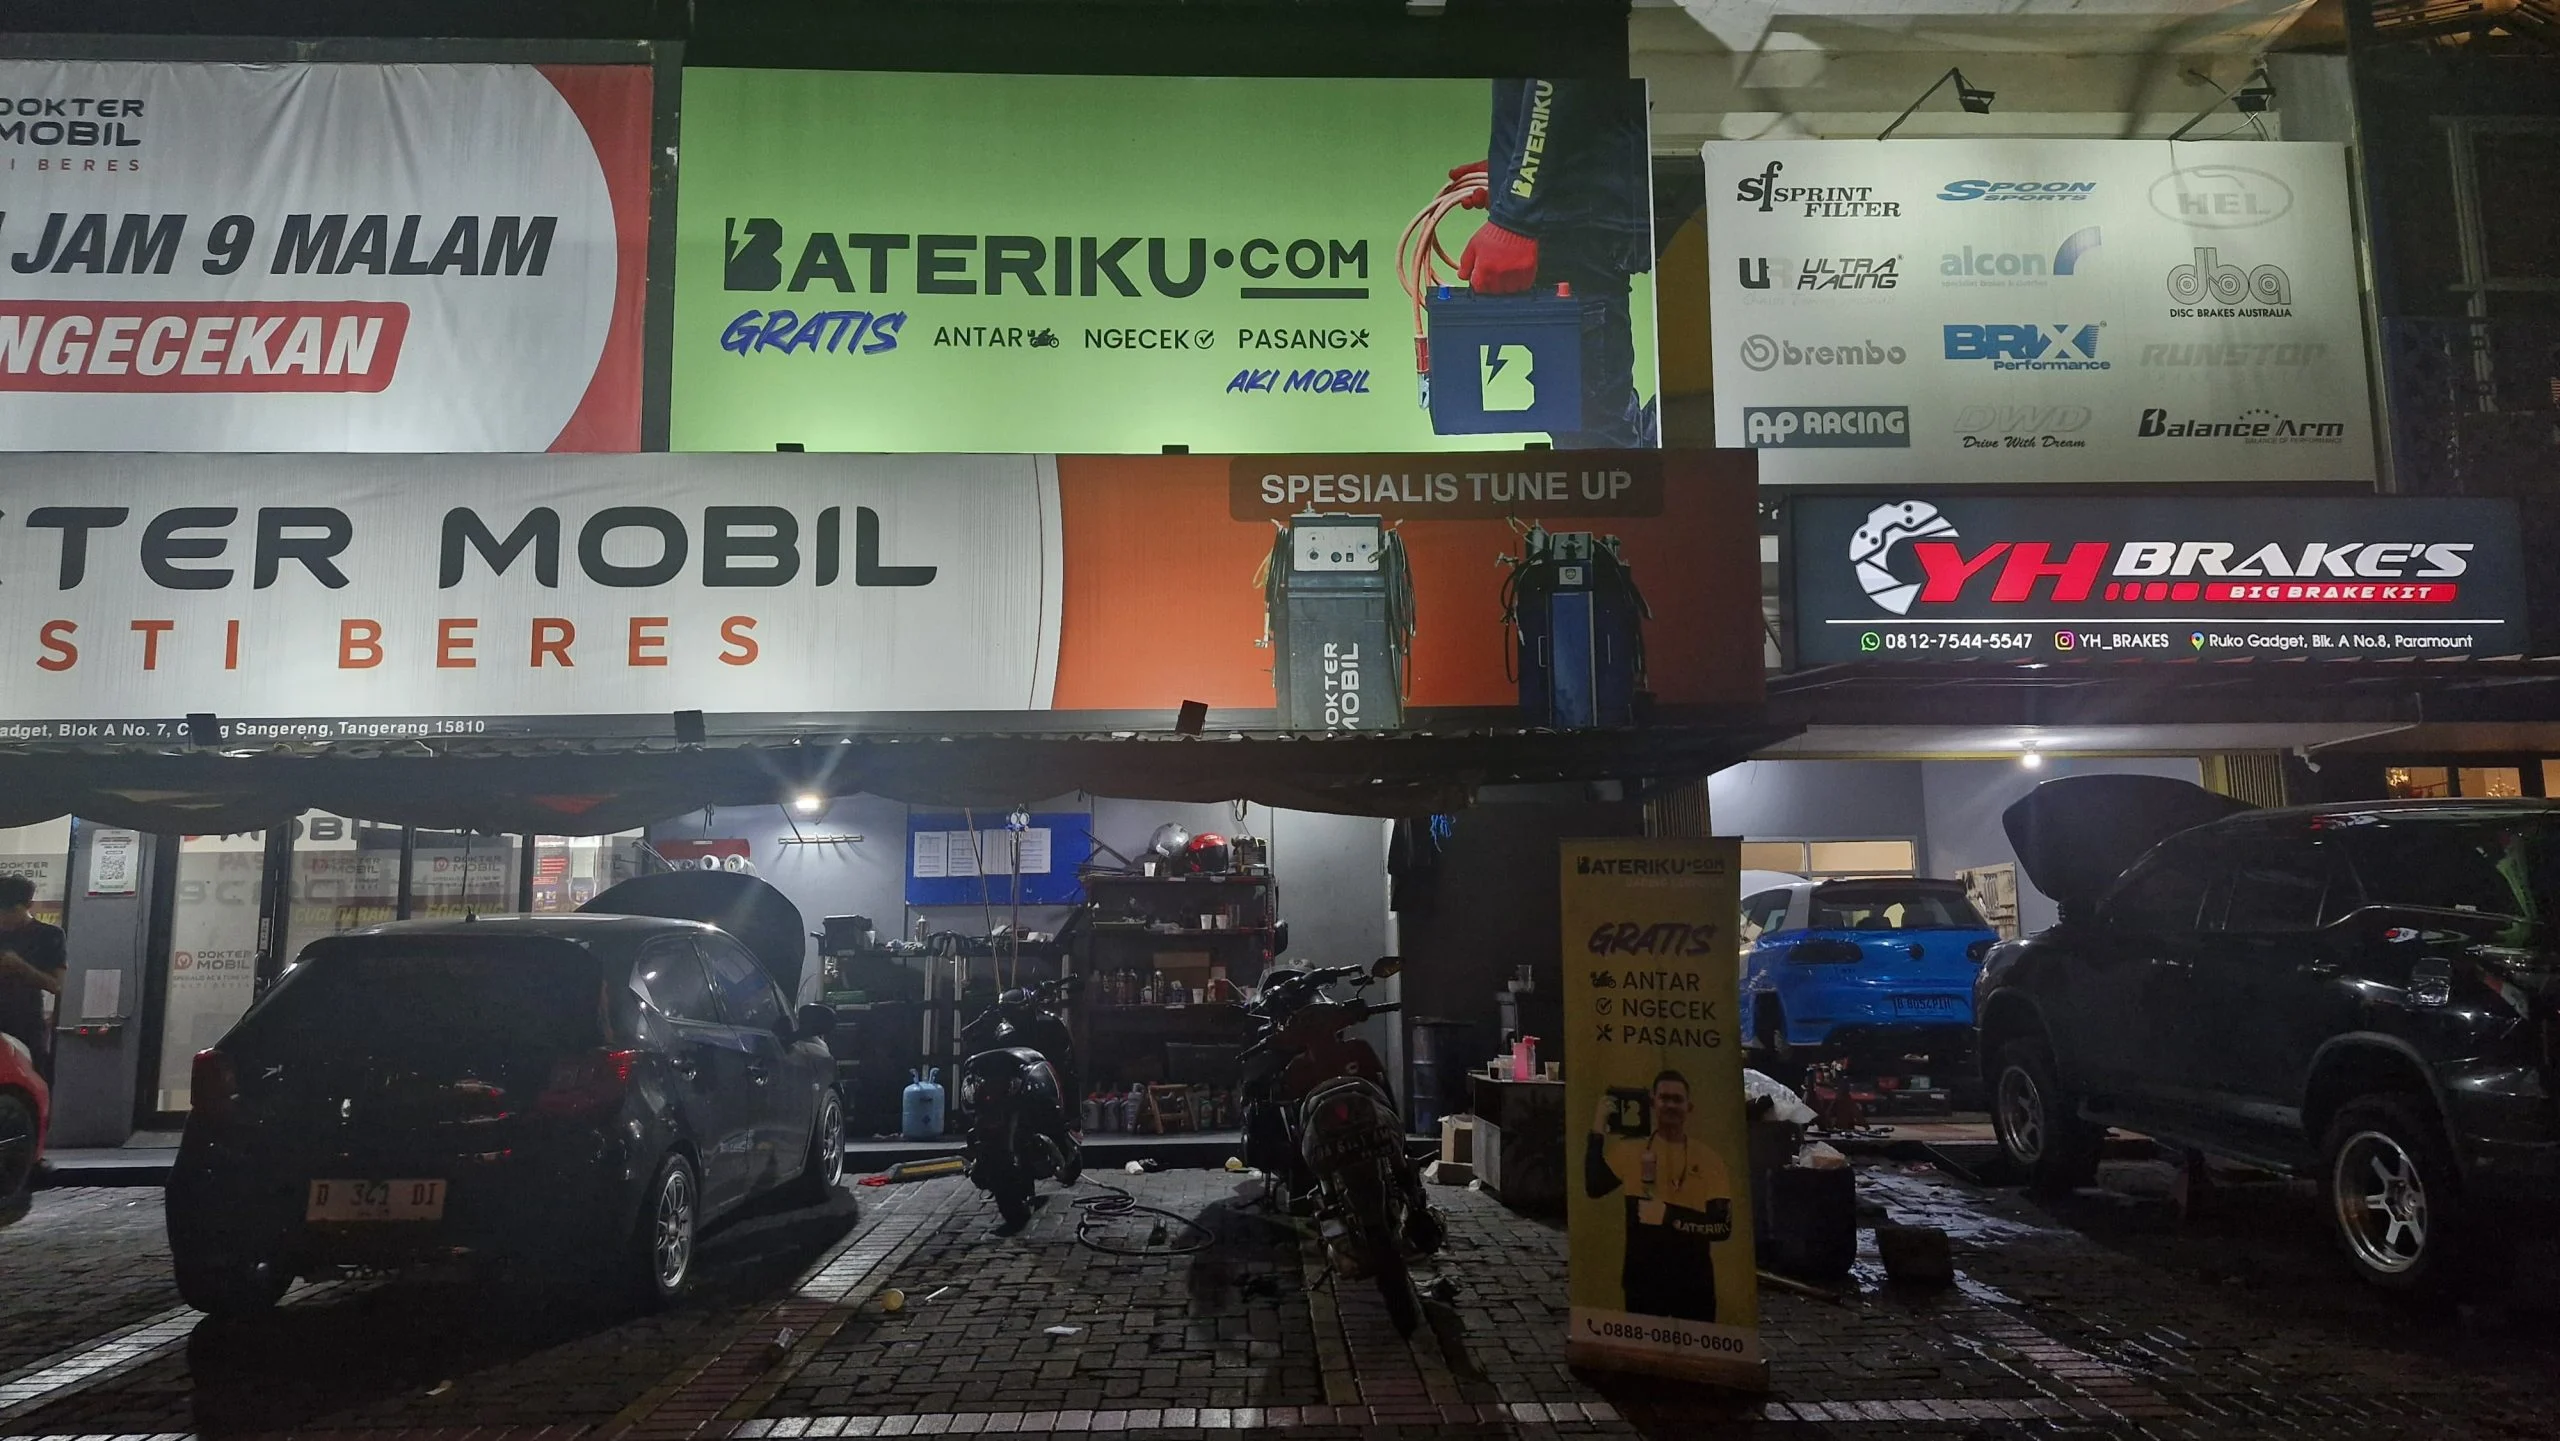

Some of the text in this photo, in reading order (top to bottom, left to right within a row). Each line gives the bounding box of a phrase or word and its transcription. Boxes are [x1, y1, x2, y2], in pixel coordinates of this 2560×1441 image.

[0, 121, 142, 146] MOBIL
[1511, 80, 1554, 199] BATERIKU
[38, 158, 140, 171] BERES
[1774, 187, 1873, 202] SPRINT
[1936, 179, 2096, 201] SPOON
[1803, 202, 1902, 218] FILTER
[11, 213, 558, 276] JAM 9 MALAM
[1802, 257, 1896, 274] ULTRA
[1940, 245, 2046, 276] alcon
[1797, 273, 1899, 290] RACING
[2167, 247, 2291, 305] dba
[2170, 308, 2293, 318] DISC BRAKES AUSTRALIA
[721, 309, 1349, 357] GRATIS ANTAR NGECEK PASANG
[0, 315, 384, 376] NGECEKAN
[1783, 339, 1907, 365] brembo
[2140, 343, 2327, 367] RUNSTOP
[1994, 360, 2111, 371] Performance
[1226, 368, 1370, 394] AKI MOBIL
[1748, 411, 1905, 444] AP RACING
[1953, 404, 2092, 433] DWD
[2138, 408, 2345, 437] Balance Arm
[1963, 435, 2086, 448] Drive With Dream
[1261, 471, 1633, 505] SPESIALIS TUNE UP
[0, 505, 938, 591] TER MOBIL
[1913, 541, 2475, 602] YH BRAKE'S
[2229, 586, 2433, 599] BIG BRAKE KIT
[337, 615, 761, 670] BERES
[1885, 633, 2169, 650] 0812-7544-5547 YH_BRAKES
[2209, 634, 2244, 648] Ruko
[2247, 634, 2308, 651] Gadget,
[2338, 634, 2350, 648] A
[2354, 634, 2391, 650] No.8,
[2395, 634, 2473, 648] Paramount
[1324, 642, 1339, 730] OKTER
[58, 722, 99, 738] Blok
[104, 723, 117, 737] A
[122, 723, 151, 737] No.
[156, 723, 171, 739] 7,
[235, 721, 334, 738] Sangereng,
[338, 720, 429, 737] Tangerang
[435, 720, 485, 733] 15810
[1588, 922, 1719, 957] GRATIS
[196, 959, 250, 970] MOBIL
[1622, 971, 1701, 992] ANTAR
[1622, 997, 1716, 1021] NGECEK
[1623, 1025, 1721, 1048] PASANG
[1603, 1322, 1744, 1353] 0888-0860-0600
